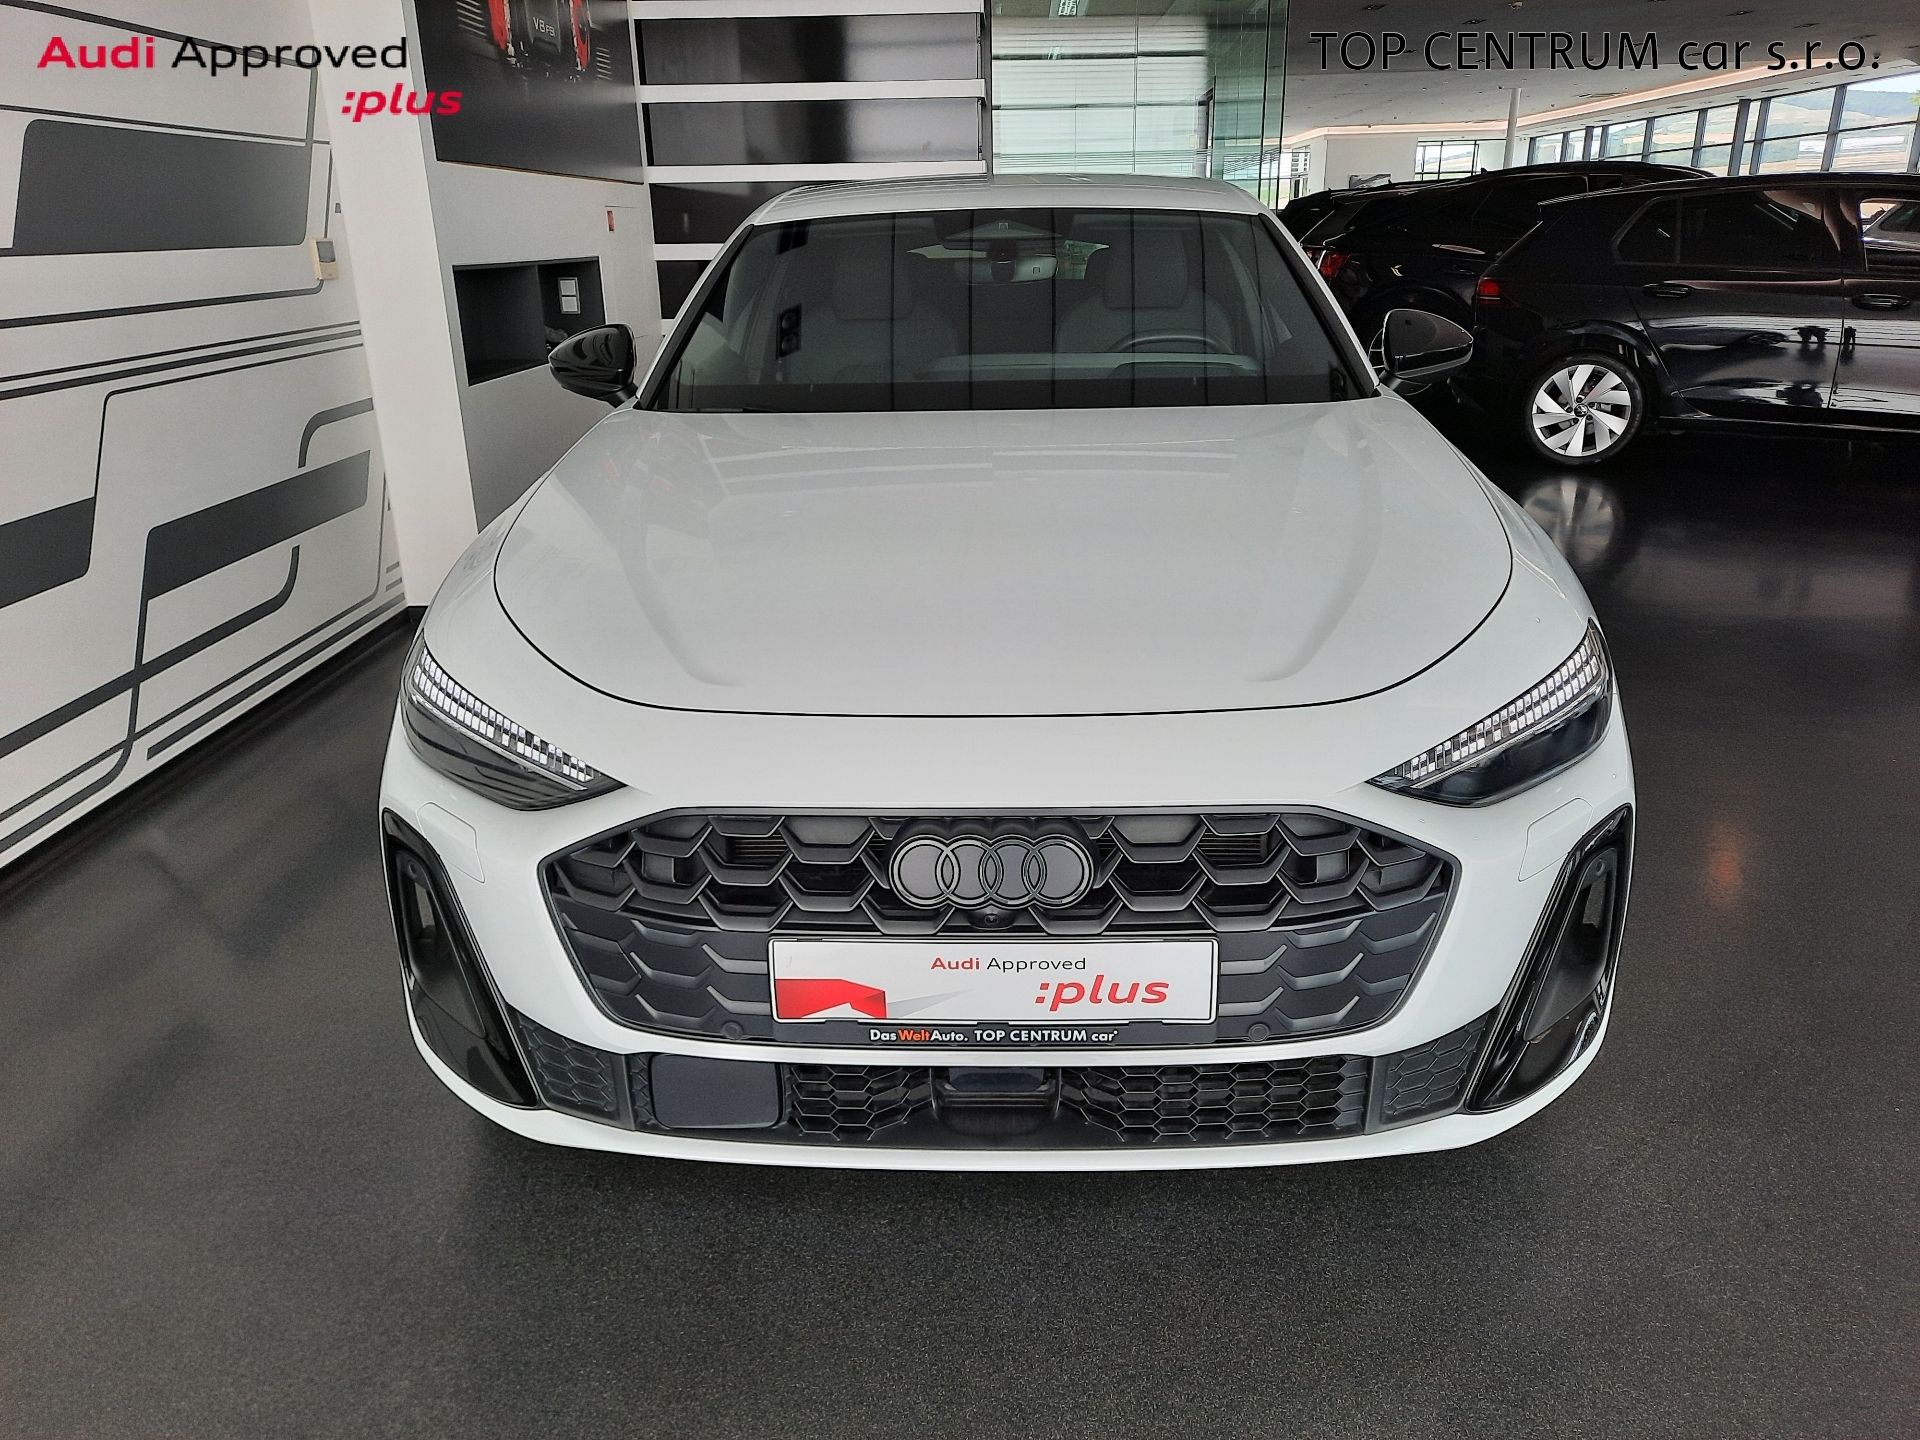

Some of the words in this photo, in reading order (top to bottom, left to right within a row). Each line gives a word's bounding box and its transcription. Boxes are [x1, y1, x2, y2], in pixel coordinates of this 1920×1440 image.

[532, 16, 545, 33] V8
[930, 957, 980, 970] Audi
[987, 957, 1086, 973] Approved
[1035, 974, 1169, 1012] :plus
[974, 1029, 1006, 1041] TOP
[1009, 1029, 1087, 1042] CENTRUM
